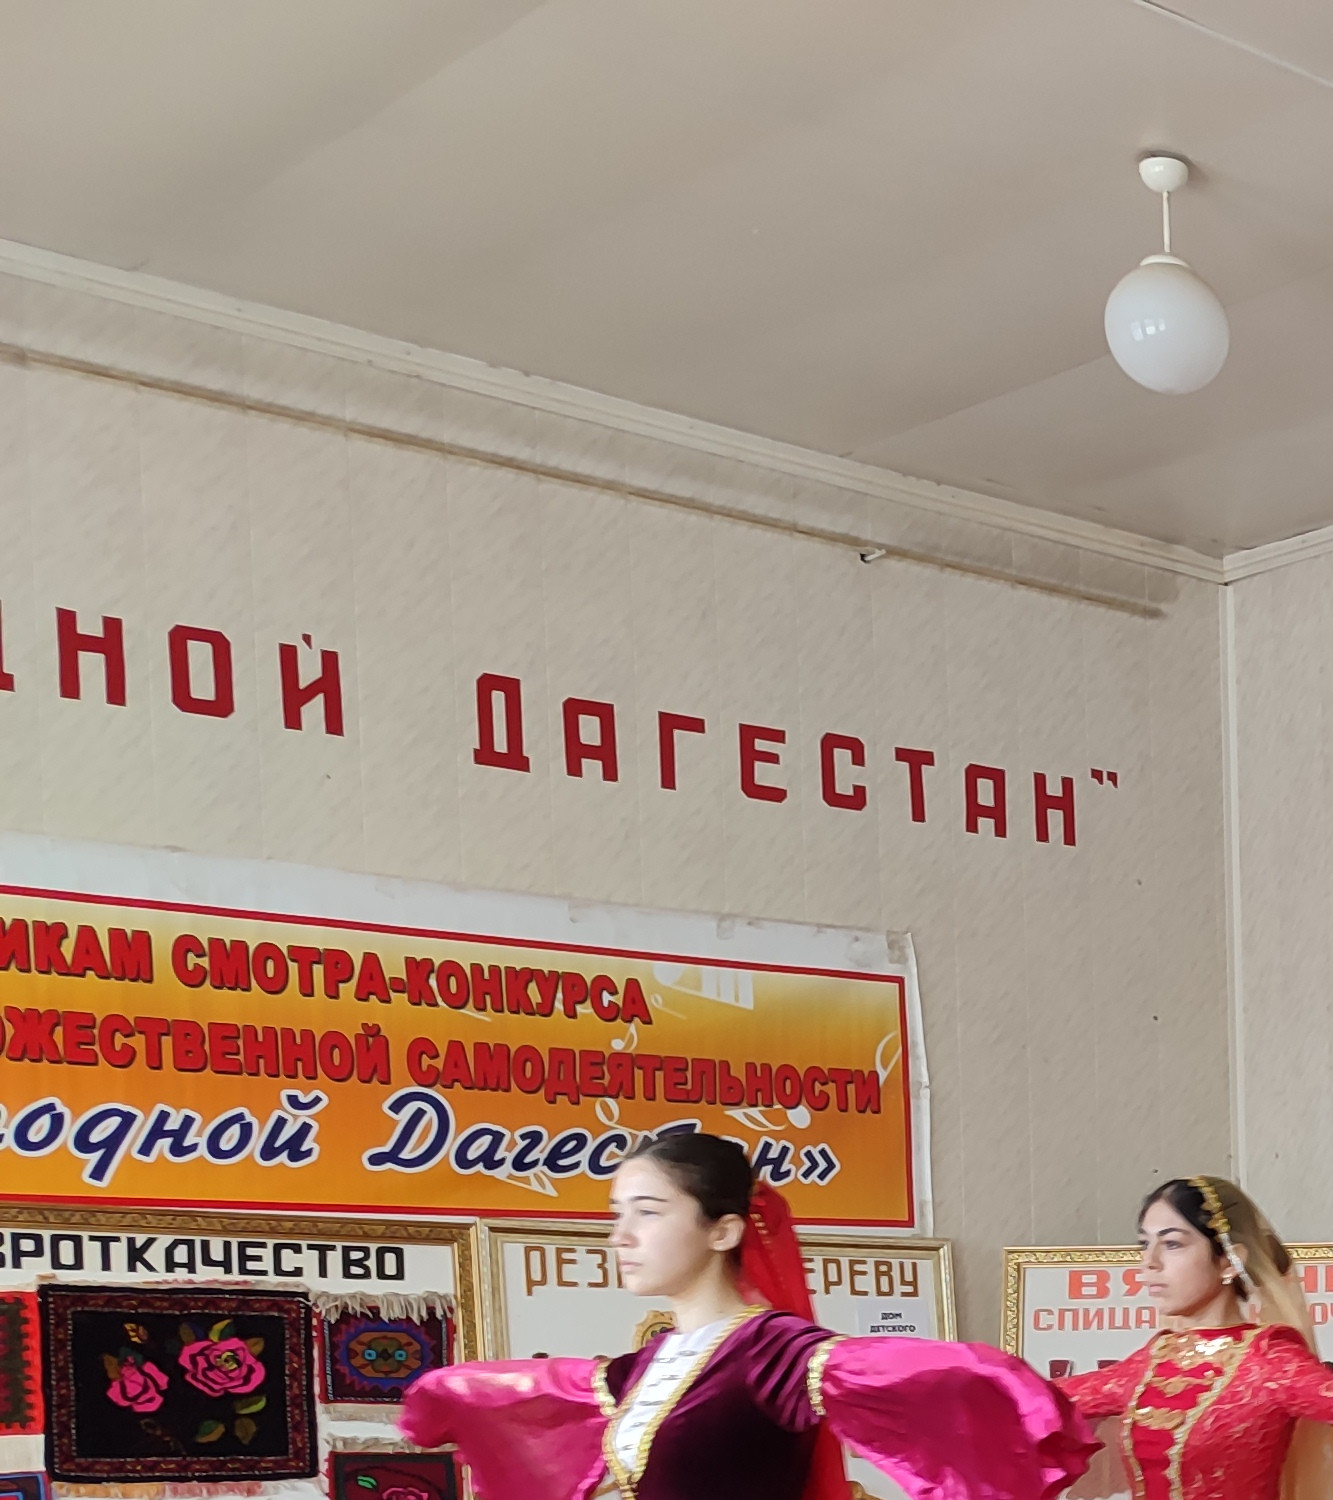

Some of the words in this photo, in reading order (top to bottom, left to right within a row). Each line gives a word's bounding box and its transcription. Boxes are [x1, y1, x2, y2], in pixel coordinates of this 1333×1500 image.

[0, 604, 345, 737] НОЙ
[171, 934, 653, 1025] СМОТРА-КОНКУРСА
[0, 1005, 391, 1085] ЖЕСТВЕННОЙ
[406, 1036, 882, 1114] САМОДЕЯТЕЛЬНОСТИ
[0, 1092, 322, 1184] одной
[0, 1232, 405, 1280] РОТКАЧЕСТВО
